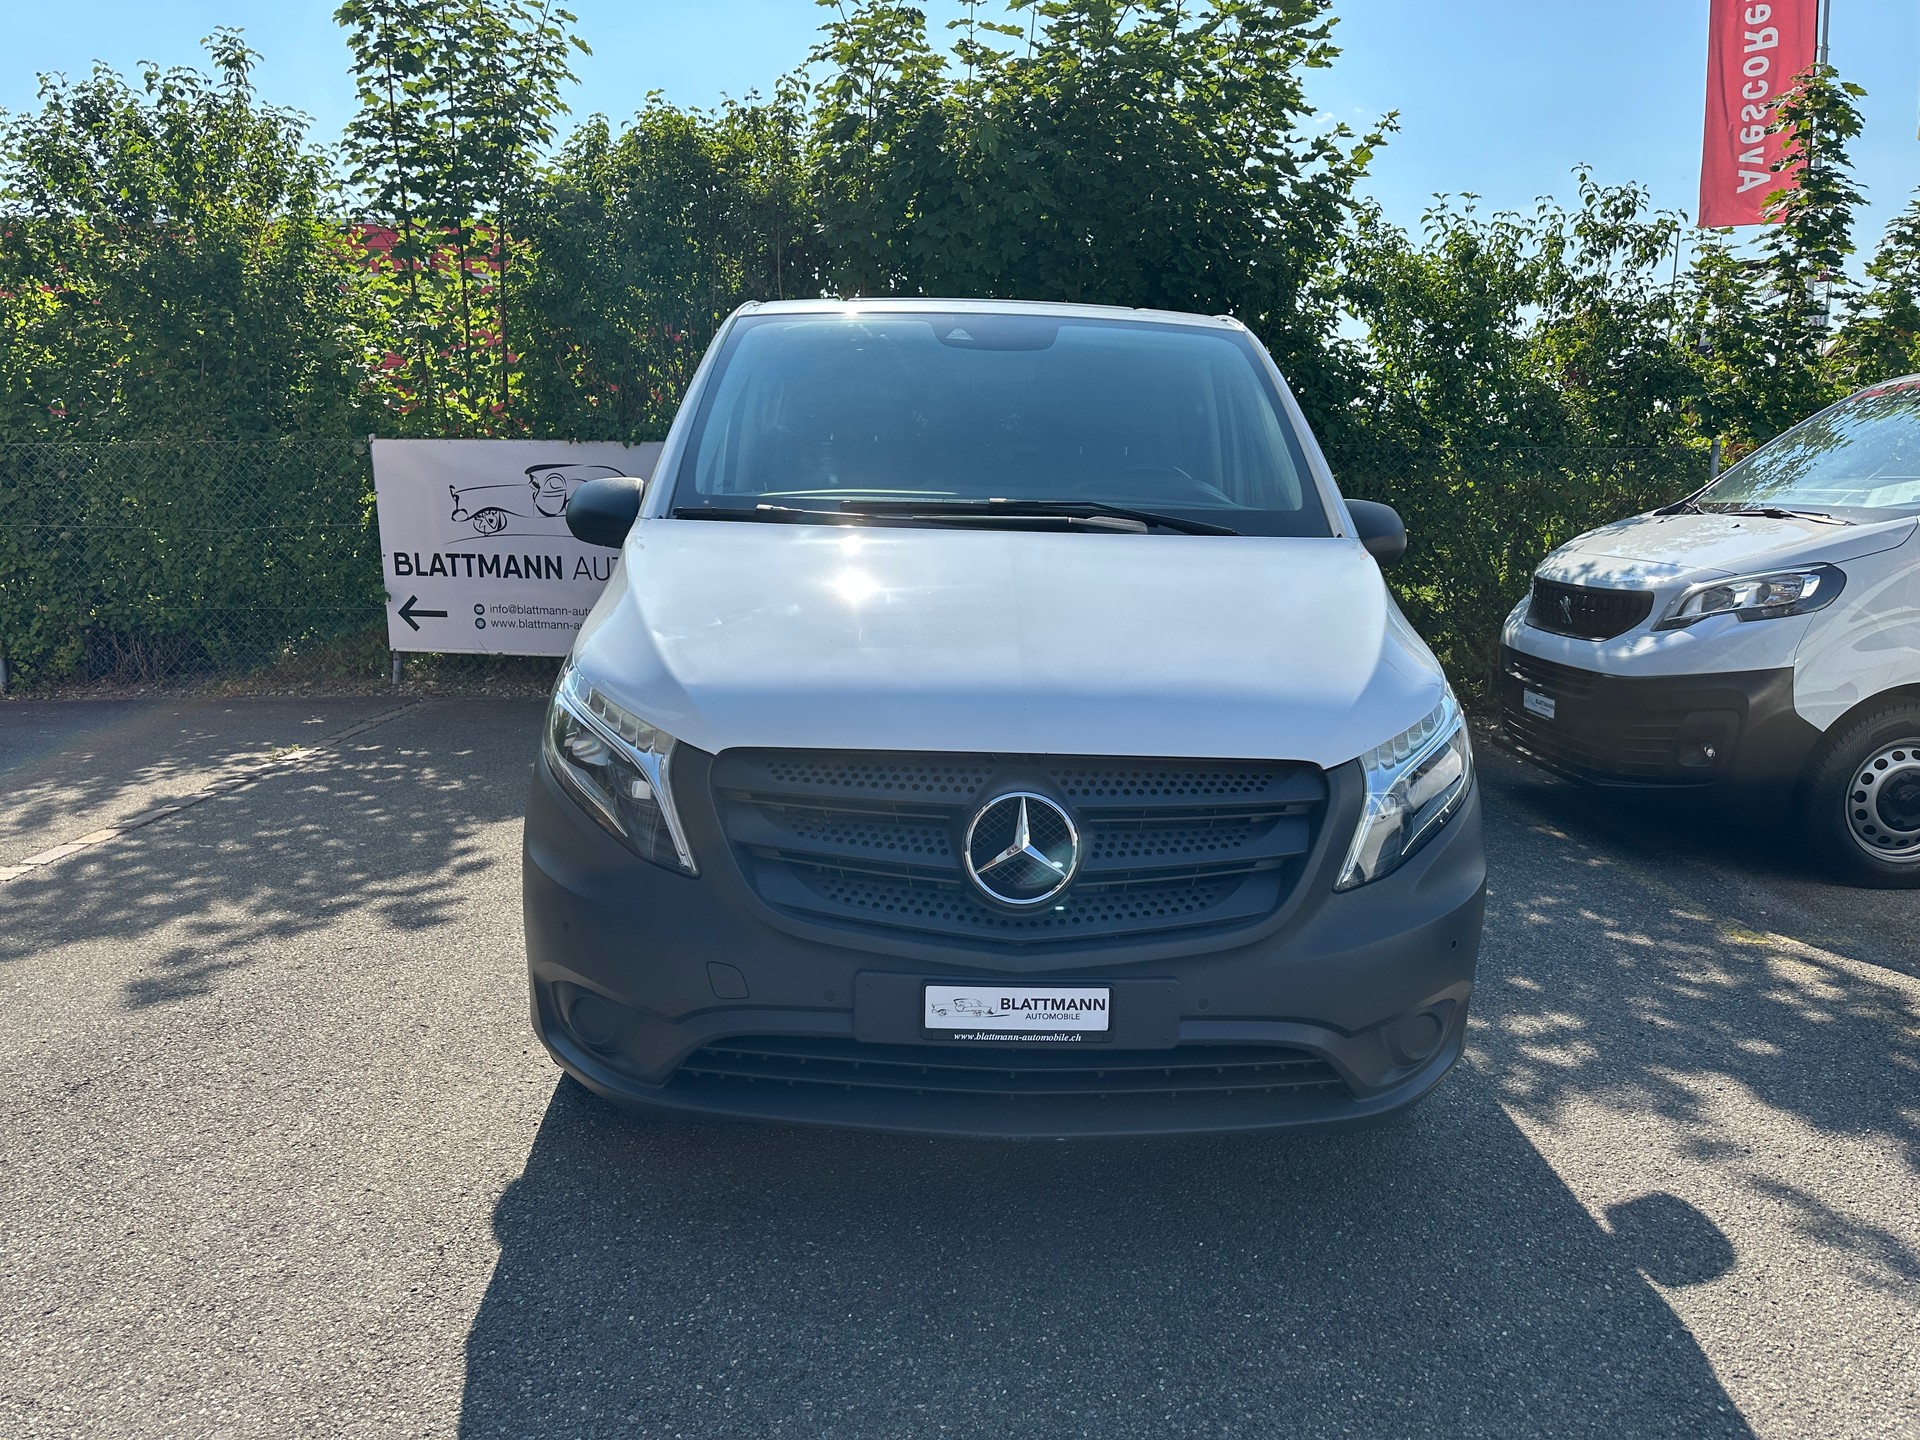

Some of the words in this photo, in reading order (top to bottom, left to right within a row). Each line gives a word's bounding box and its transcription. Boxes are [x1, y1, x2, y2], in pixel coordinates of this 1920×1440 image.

[393, 552, 563, 580] BLATTMANN
[1000, 998, 1106, 1011] BLATTMANN
[953, 1032, 1082, 1042] www.blattmann-automobile.ch
